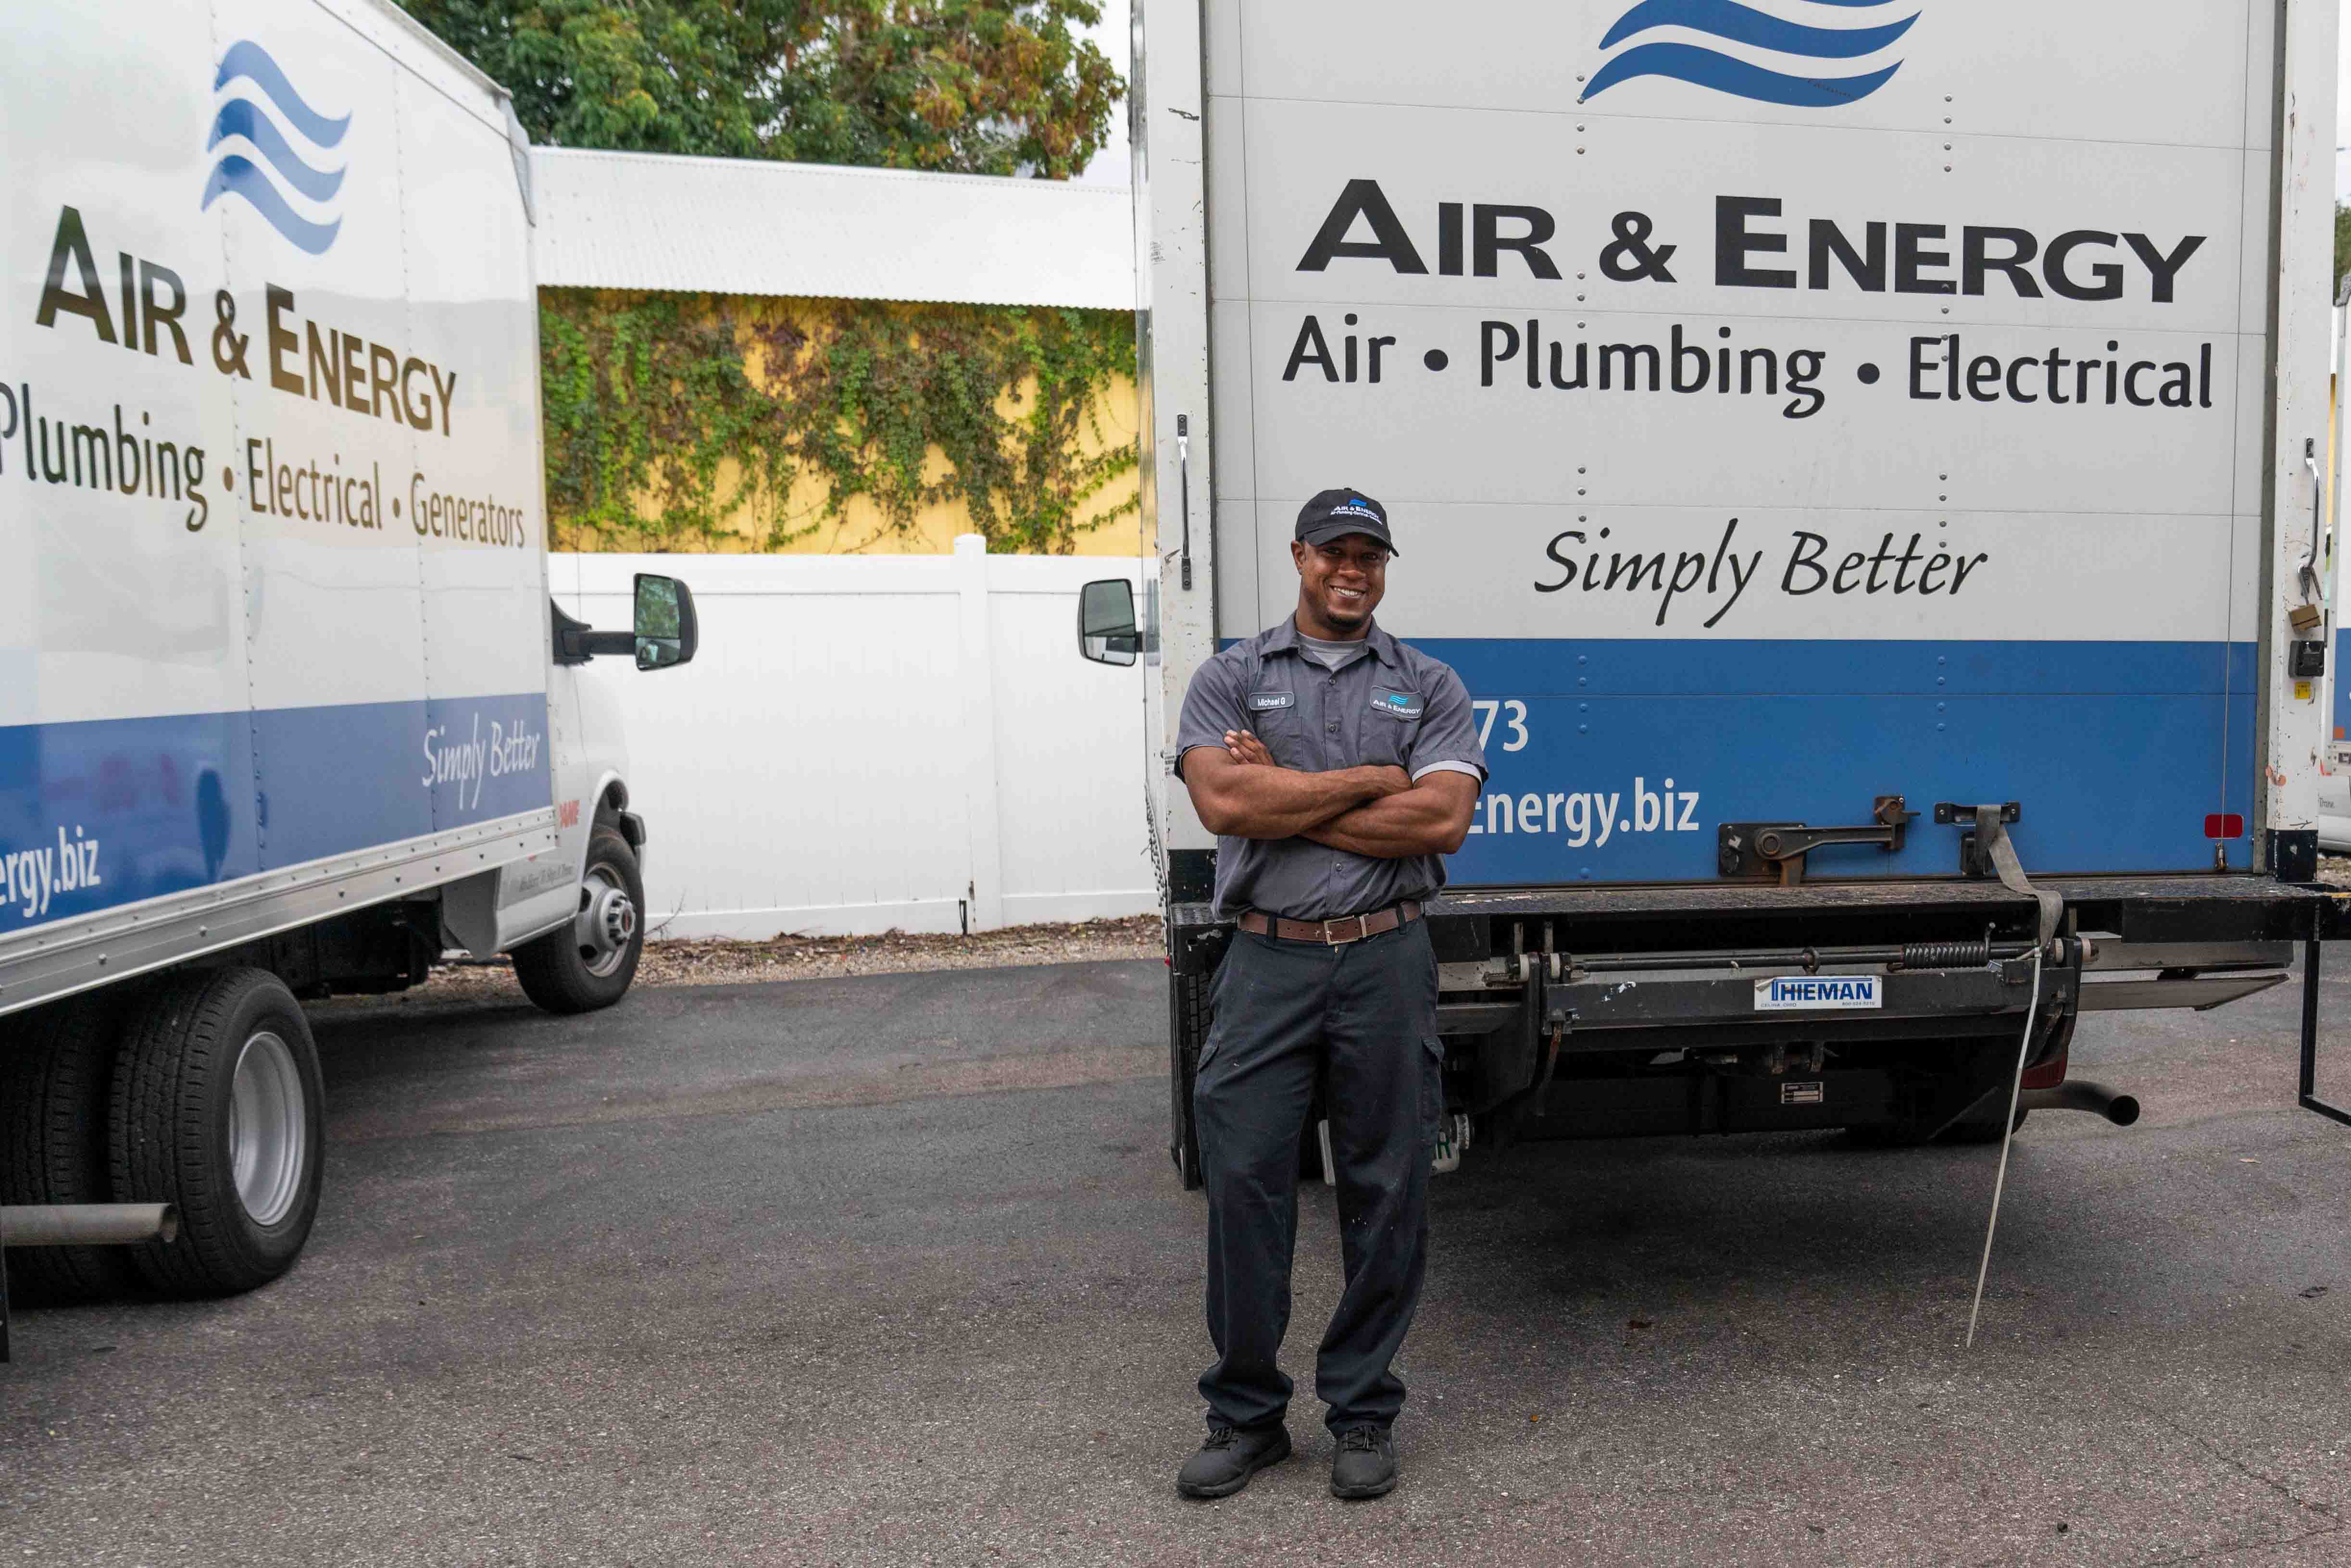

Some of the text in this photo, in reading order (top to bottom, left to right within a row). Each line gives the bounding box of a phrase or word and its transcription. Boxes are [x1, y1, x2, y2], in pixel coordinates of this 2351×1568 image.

[1295, 179, 2207, 303] AIR & ENERGY
[36, 205, 457, 437] AIR & ENERGY
[1282, 313, 2212, 419] Air Plumbing Electrical
[246, 437, 382, 530] Electrical
[410, 472, 525, 548] Generators
[1534, 518, 1988, 628] Simply Better
[1258, 698, 1279, 707] Michael
[1473, 699, 1528, 752] 73
[422, 712, 486, 810] Simply
[490, 719, 540, 776] Better
[1771, 977, 1872, 1001] THIEMAN
